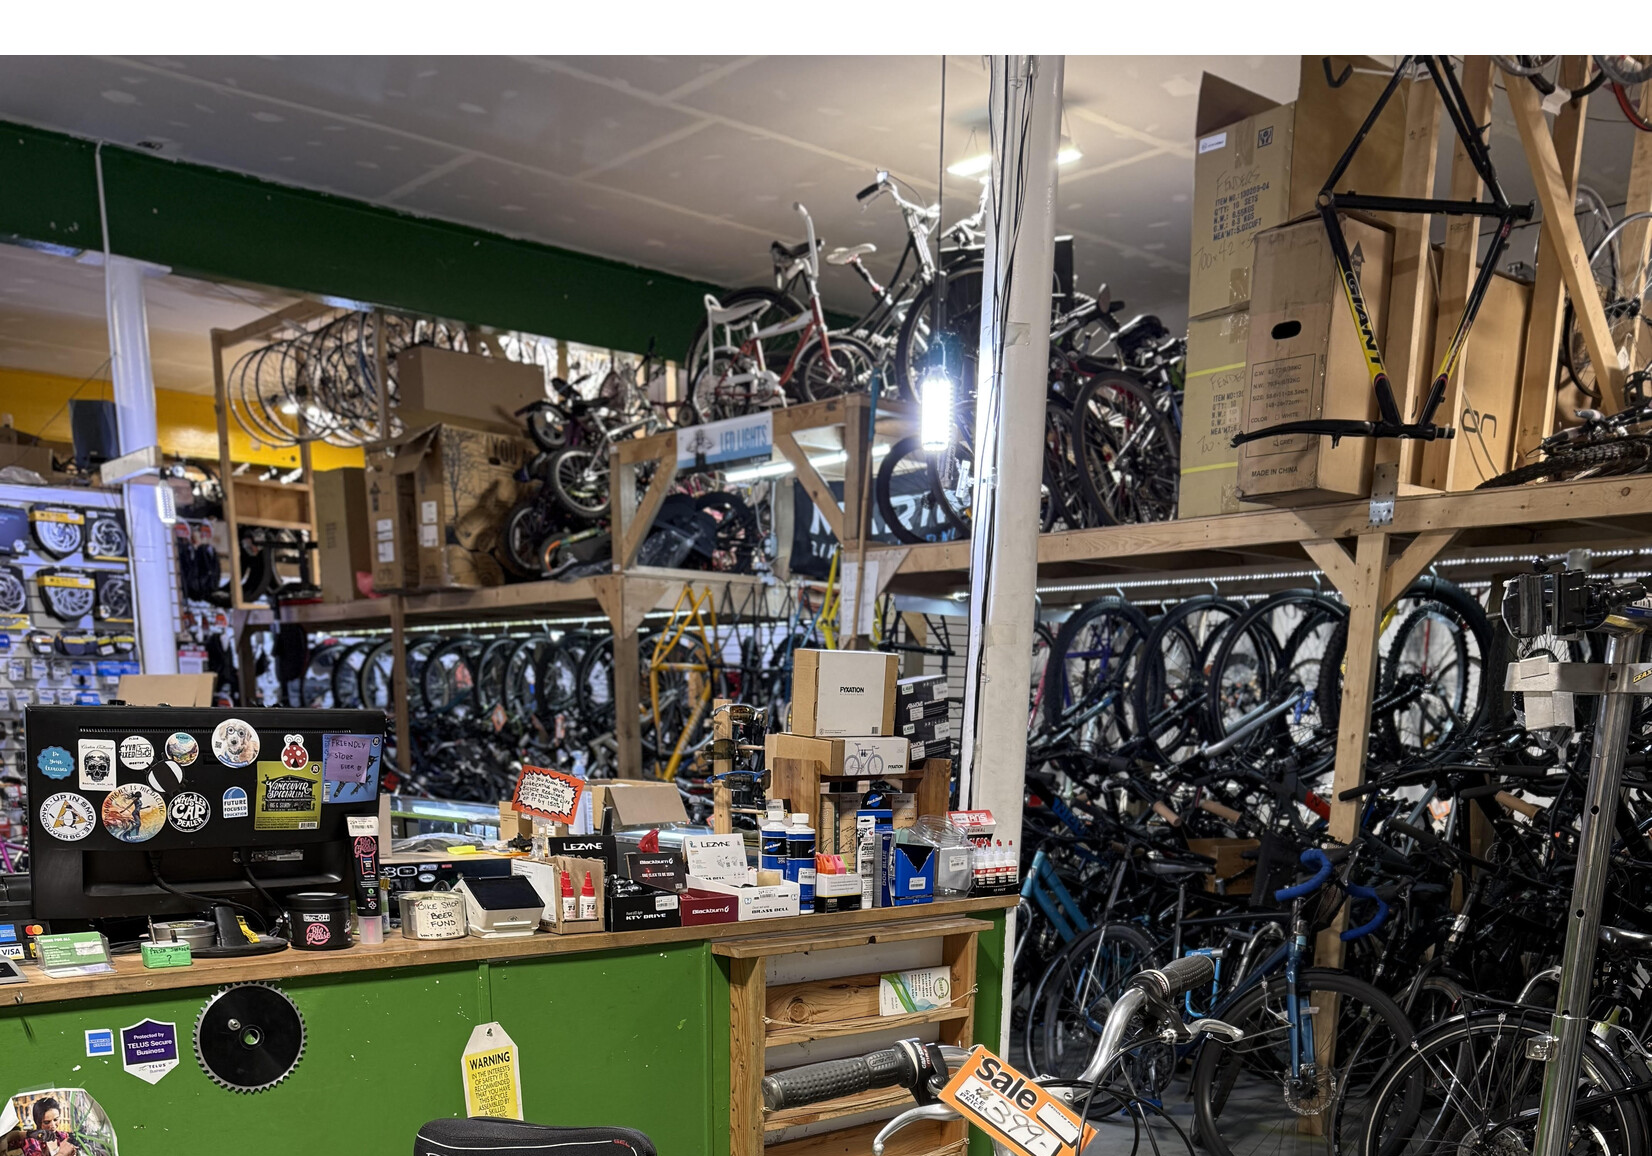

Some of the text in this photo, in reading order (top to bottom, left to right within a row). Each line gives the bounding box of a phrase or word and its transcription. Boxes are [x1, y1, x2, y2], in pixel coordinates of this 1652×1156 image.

[1215, 196, 1228, 207] ITEM
[1244, 194, 1259, 206] SETS
[1243, 213, 1255, 222] KGS
[1344, 271, 1385, 371] GIANT
[1213, 394, 1226, 402] ITEM
[720, 424, 767, 454] LED LIGHTS
[1251, 469, 1270, 477] MADE
[1278, 465, 1298, 474] CHINA
[839, 686, 865, 694] FYXATION
[125, 743, 136, 752] YVR
[331, 738, 366, 749] FRIENDLY
[266, 779, 309, 794] VANCOUVER
[267, 789, 296, 799] SPECIAL
[52, 794, 94, 834] UP IN SMOKE
[172, 803, 206, 820] CAP
[41, 803, 69, 840] VANCOUVER
[177, 817, 205, 828] DEALER
[562, 842, 603, 851] LEZYNE
[700, 840, 731, 848] LEZYNE
[417, 900, 459, 910] BIKE SHOP
[692, 906, 726, 915] Blackburn
[430, 911, 453, 920] BEER
[1, 948, 20, 956] VISA
[127, 1039, 173, 1049] TELUS Secure
[136, 1048, 165, 1056] Business
[469, 1051, 511, 1071] WARNING
[478, 1070, 487, 1078] THE
[487, 1065, 511, 1076] INTERESTS
[482, 1074, 498, 1084] SAFETY
[976, 1057, 1037, 1111] Sale
[474, 1078, 511, 1092] RECOMMENDED
[476, 1091, 487, 1099] THAT
[499, 1084, 511, 1092] HAVE
[479, 1091, 508, 1104] THIS BICYCLE
[960, 1092, 984, 1112] PRICE
[965, 1089, 985, 1106] SALE
[478, 1099, 504, 1112] ASSEMBLED
[489, 1105, 505, 1115] SKILLED
[613, 1138, 631, 1148] GEL
